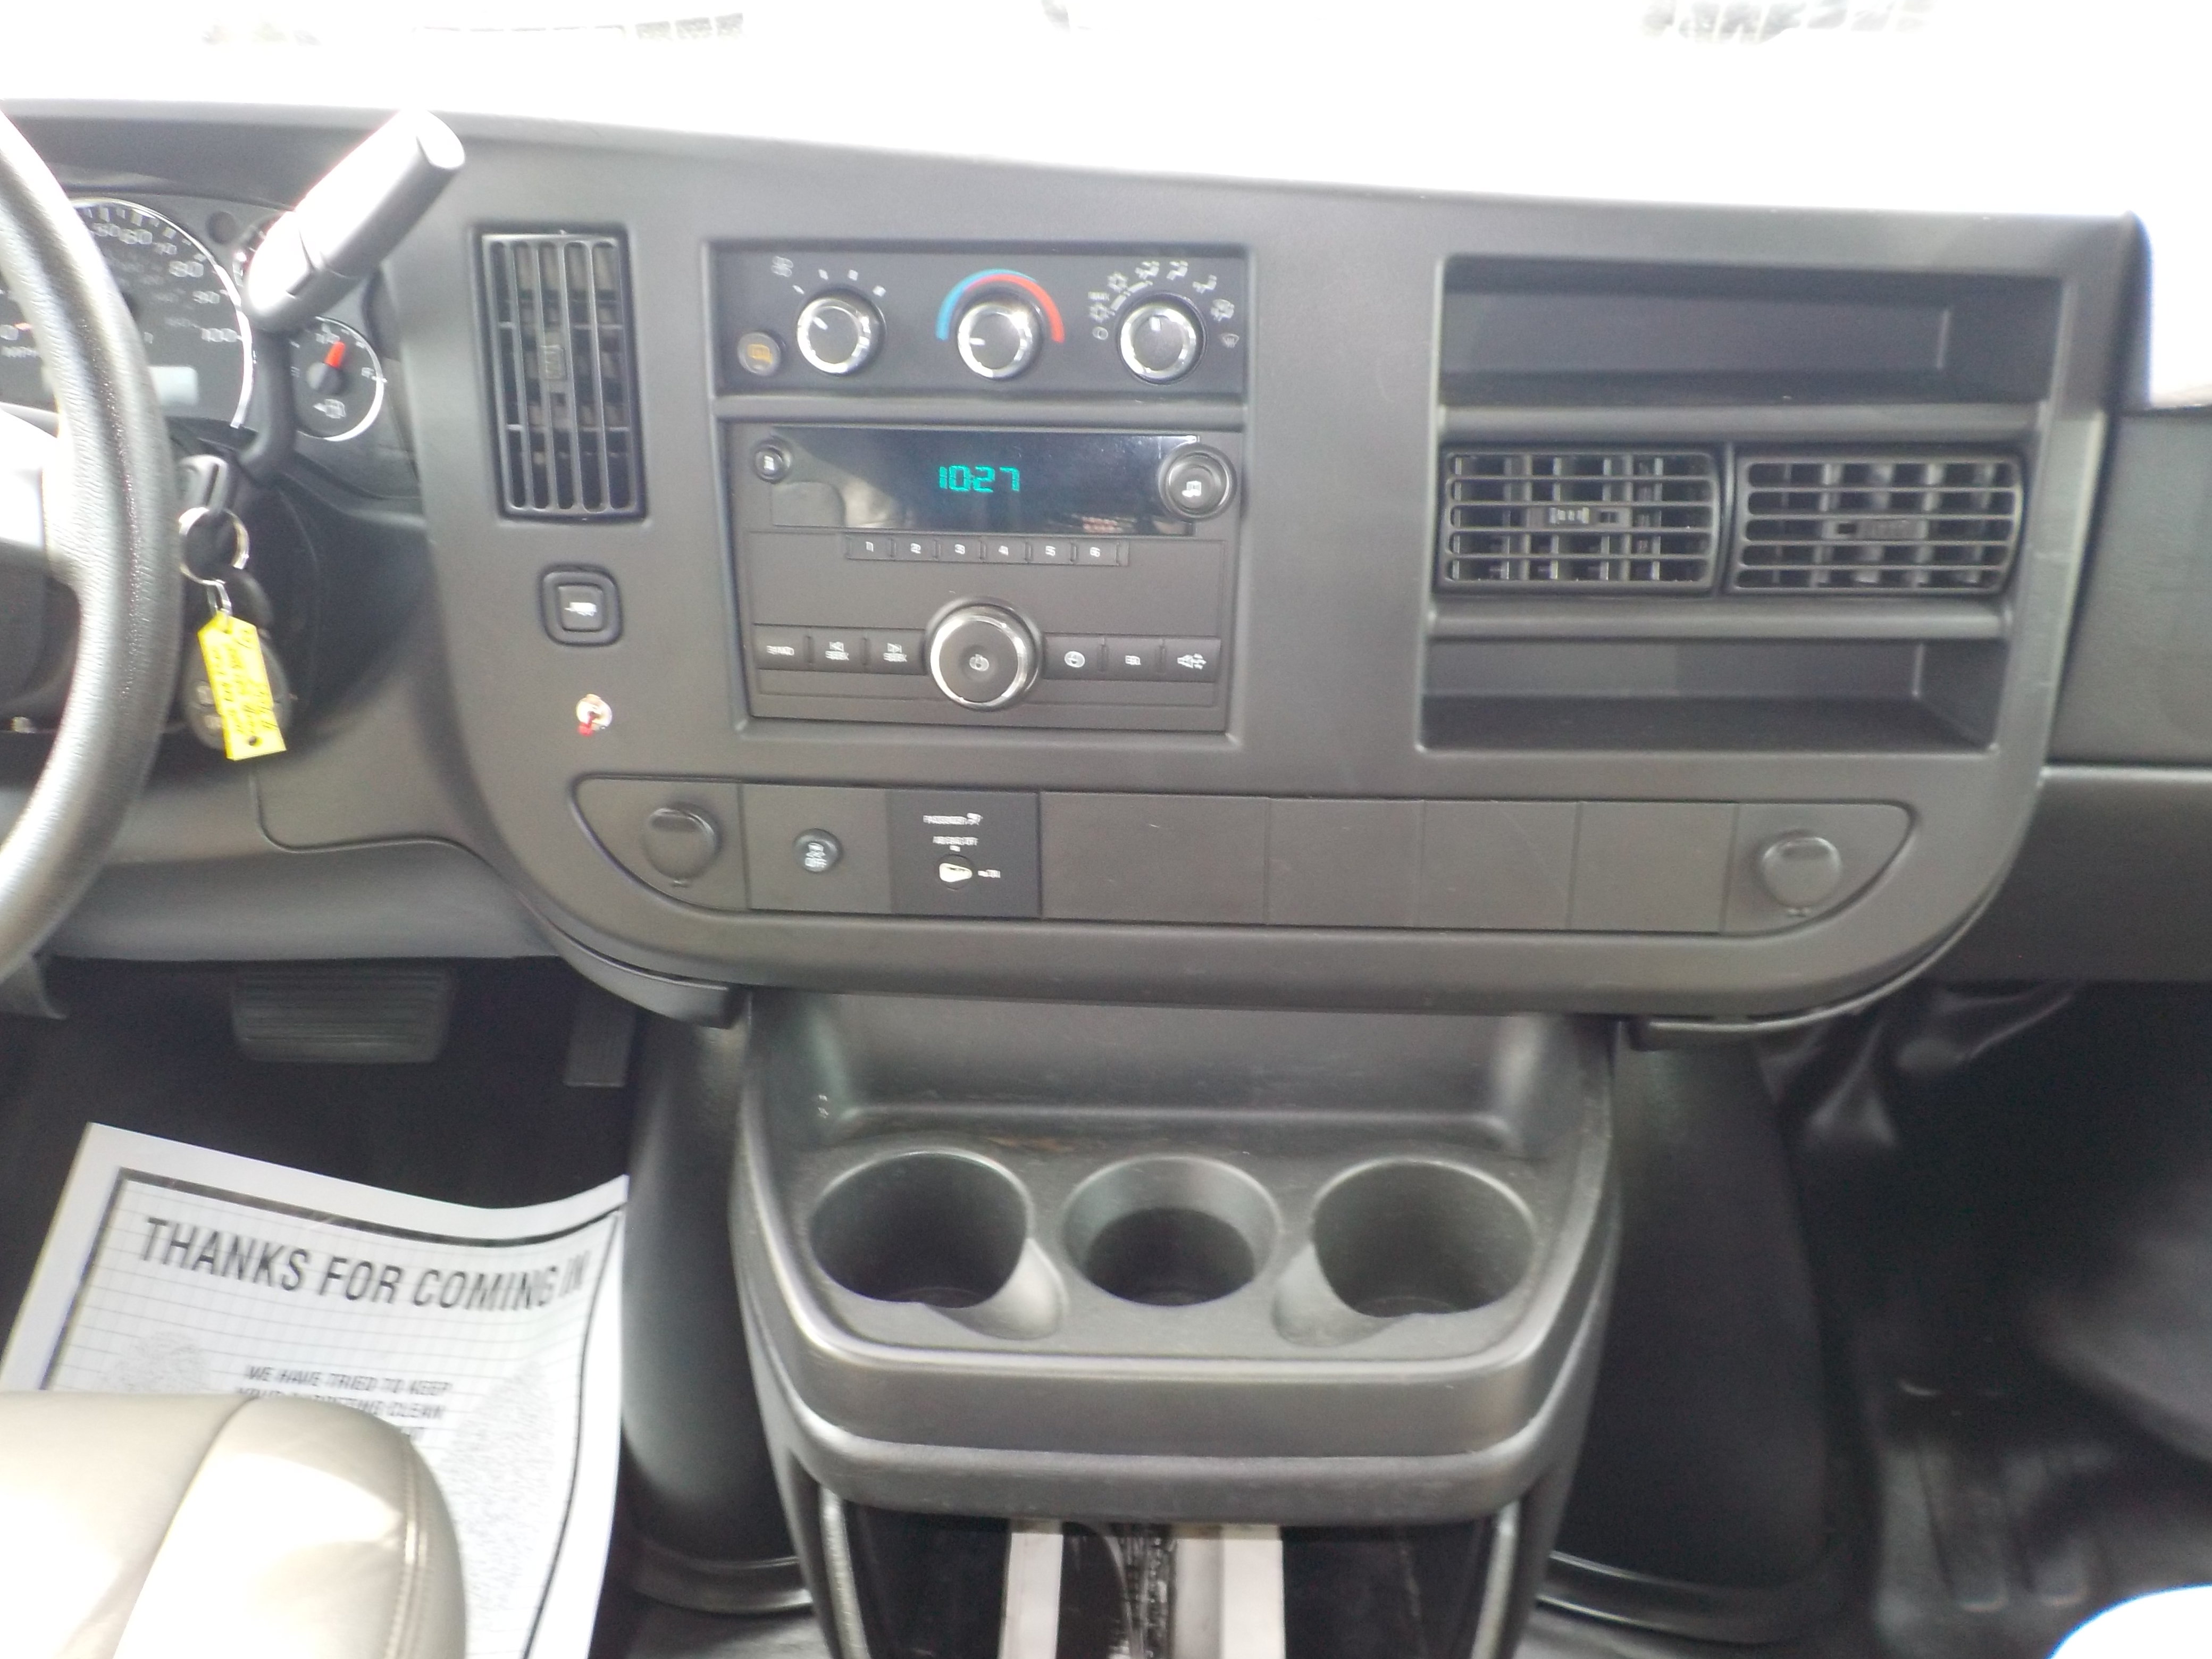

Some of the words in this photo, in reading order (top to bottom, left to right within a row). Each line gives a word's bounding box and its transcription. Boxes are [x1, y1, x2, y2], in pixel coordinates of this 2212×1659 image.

[167, 261, 204, 278] 80
[910, 543, 921, 554] 2
[954, 543, 966, 555] 3
[998, 546, 1009, 556] 4
[1045, 546, 1056, 556] 5
[1090, 547, 1101, 557] 6
[143, 1217, 308, 1291] THANKS
[319, 1255, 403, 1304] FOR
[413, 1266, 558, 1311] COMING
[559, 1250, 591, 1298] IN
[248, 1365, 273, 1382] WE
[278, 1369, 321, 1387] HAVE
[326, 1372, 379, 1392] TRIED
